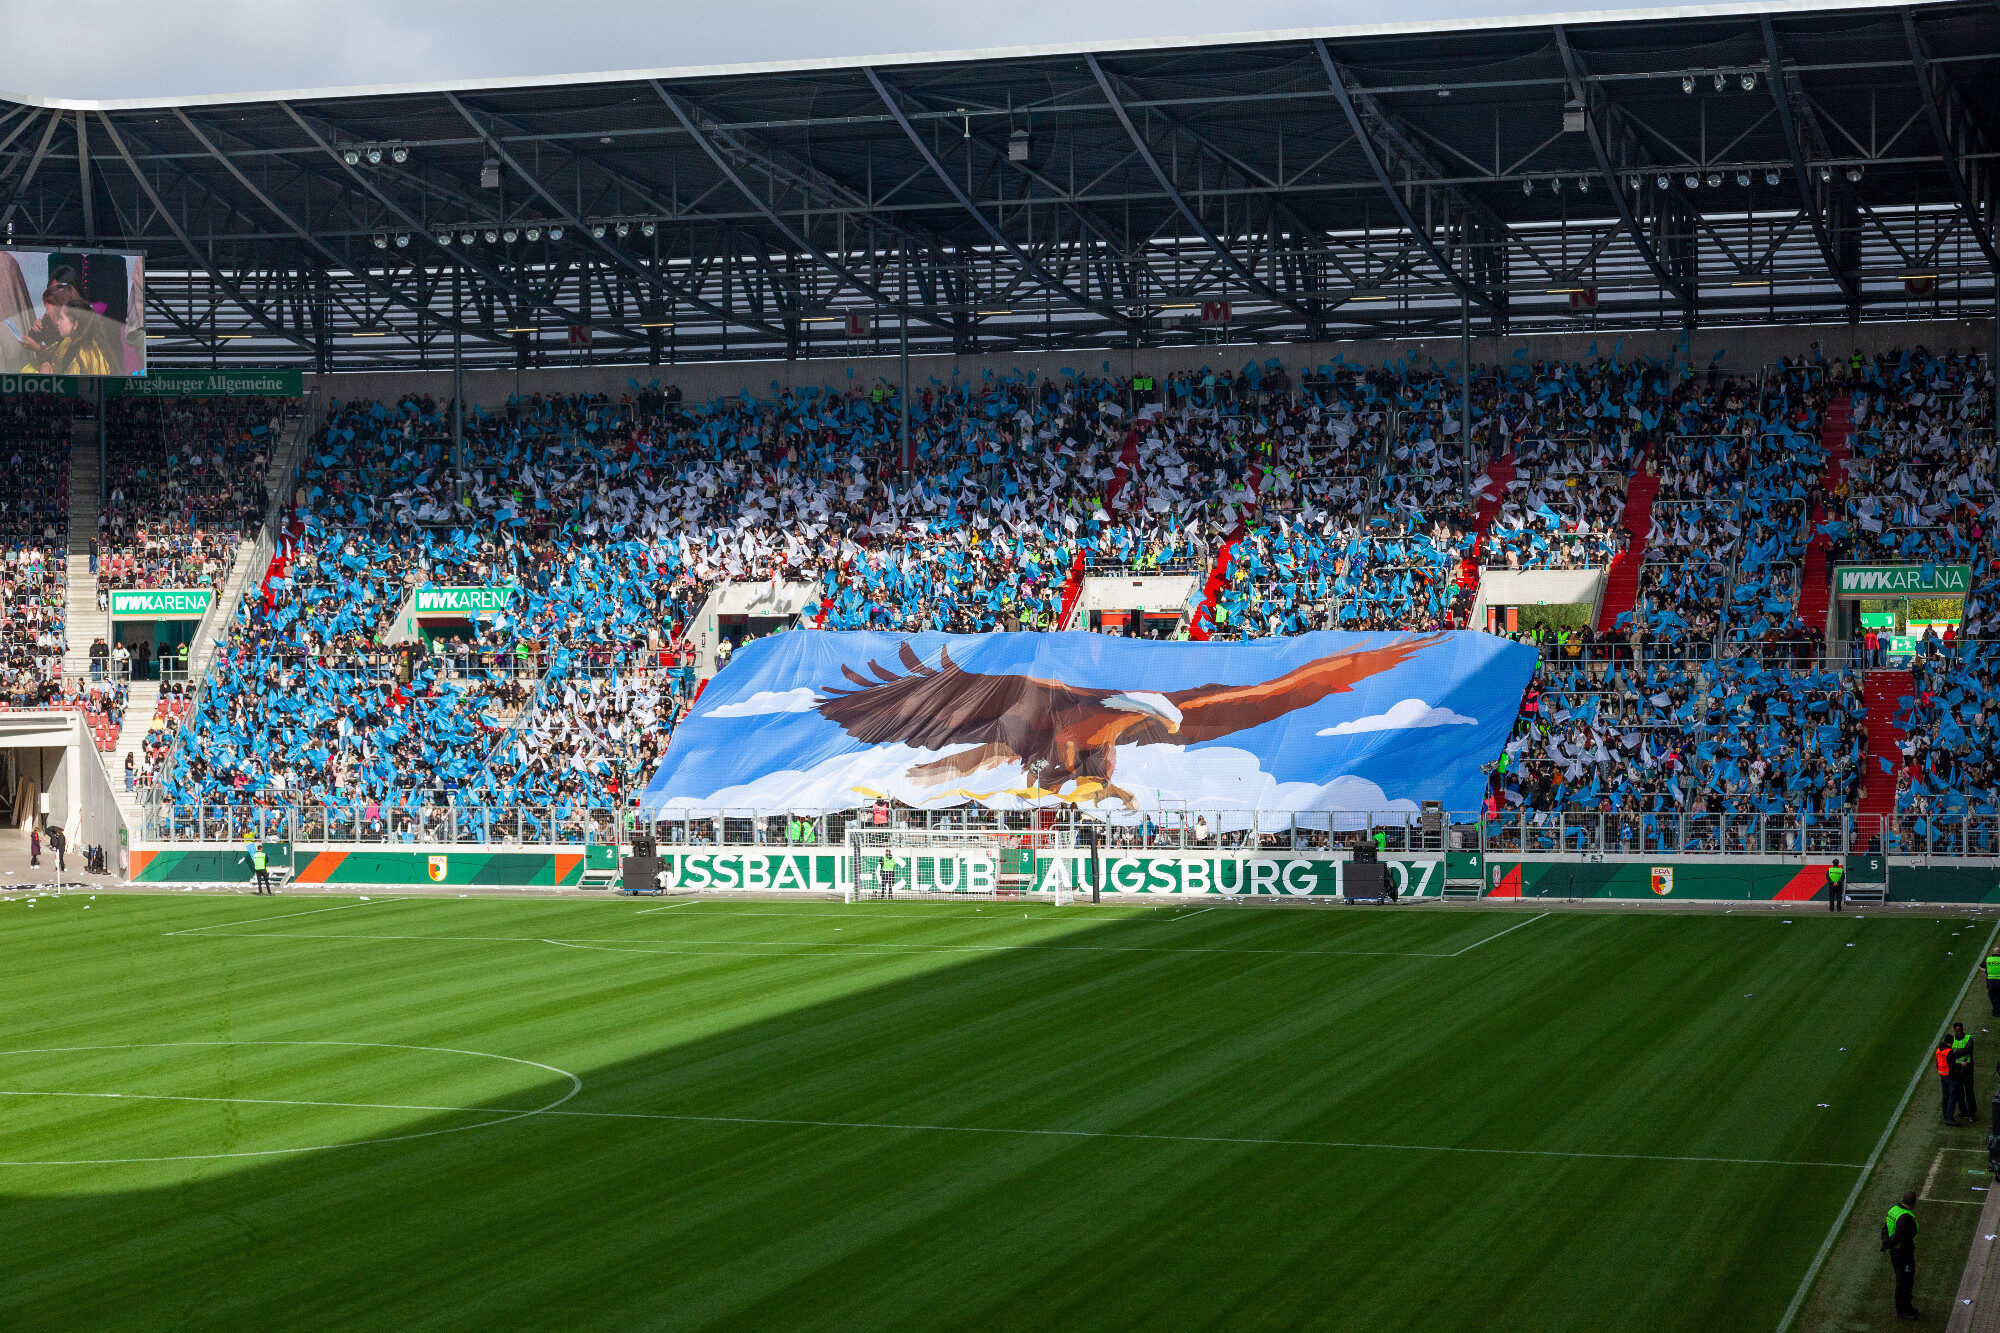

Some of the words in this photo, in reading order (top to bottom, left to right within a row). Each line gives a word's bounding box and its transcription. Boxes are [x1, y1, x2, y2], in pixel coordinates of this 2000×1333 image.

[1571, 288, 1595, 307] N
[1202, 302, 1231, 322] M
[851, 316, 863, 334] L
[571, 326, 589, 344] K
[124, 376, 202, 391] Augsburger
[208, 376, 283, 391] Allgemeine
[606, 849, 613, 859] 2
[1022, 852, 1029, 863] 3
[1469, 856, 1478, 867] 4
[1870, 860, 1878, 870] 5
[1039, 857, 1318, 896] AUGSBURG
